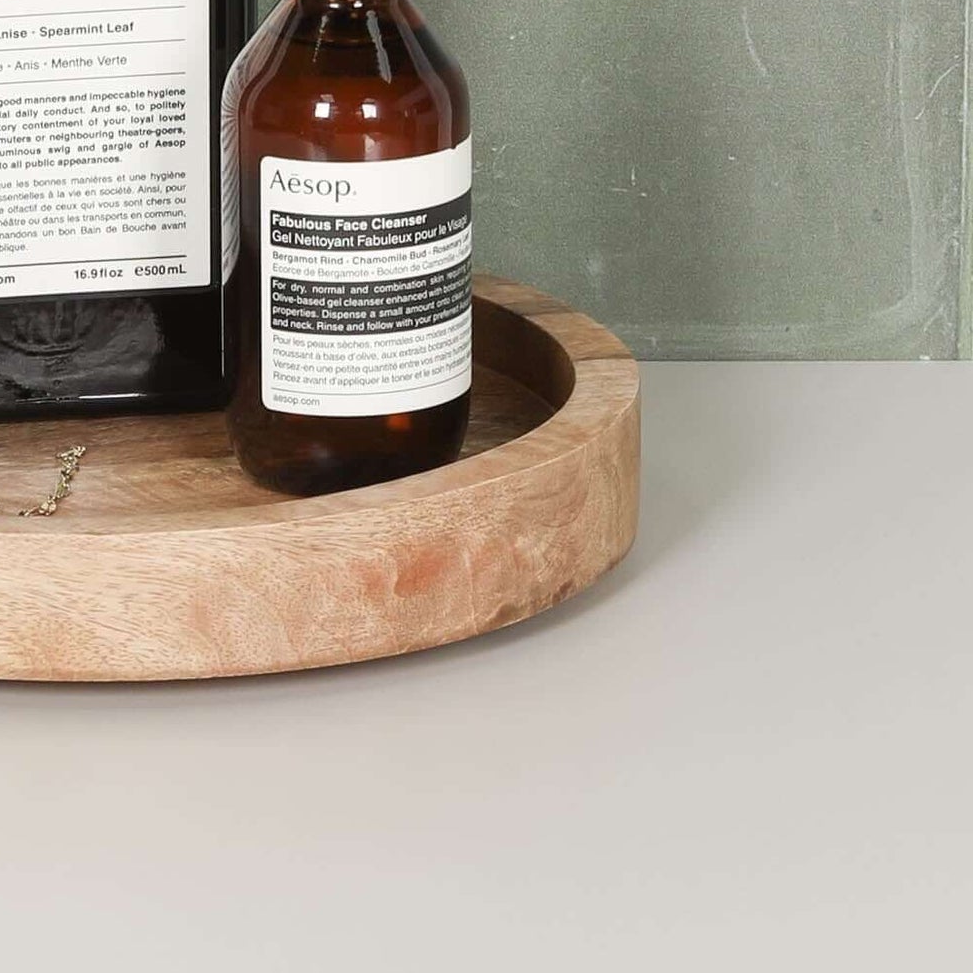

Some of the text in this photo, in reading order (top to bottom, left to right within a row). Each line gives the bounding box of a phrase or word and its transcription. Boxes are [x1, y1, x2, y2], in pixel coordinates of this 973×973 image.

[39, 23, 103, 39] Spearmint
[106, 21, 134, 33] Leaf
[13, 60, 40, 71] Anis
[50, 56, 93, 69] Menthe
[96, 55, 127, 66] Verte
[23, 95, 67, 104] manners
[68, 92, 87, 102] and
[89, 89, 145, 102] impeccable
[146, 87, 186, 99] hygiene
[14, 108, 38, 119] daily
[42, 106, 85, 116] conduct.
[90, 104, 111, 113] And
[115, 104, 130, 112] so,
[134, 102, 145, 111] to
[149, 99, 186, 112] politely
[21, 118, 83, 130] contentment
[87, 117, 98, 126] of
[102, 117, 125, 127] your
[130, 113, 154, 125] loyal
[158, 112, 186, 122] loved
[34, 134, 45, 142] or
[48, 130, 114, 142] neighbouring
[117, 126, 186, 137] theatre-goers,
[47, 144, 71, 155] swig
[76, 143, 95, 152] and
[101, 141, 133, 153] gargle
[138, 139, 149, 149] of
[154, 138, 186, 148] Aesop
[10, 159, 22, 169] all
[24, 158, 55, 170] public
[57, 155, 122, 167] appearances.
[15, 179, 29, 188] les
[32, 178, 67, 187] bonnes
[115, 173, 125, 182] et
[128, 173, 147, 182] une
[149, 170, 186, 182] hygiène
[56, 183, 187, 198] la vie en Ainsi, pour
[97, 200, 120, 208] vous
[123, 197, 143, 207] sont
[145, 196, 172, 206] chers
[173, 196, 186, 205] ou
[41, 215, 65, 224] dans
[81, 211, 128, 222] transports
[129, 211, 142, 220] en
[143, 209, 186, 219] commun,
[271, 212, 427, 231] Fabulous Face Cleanser
[41, 229, 54, 237] un
[57, 227, 76, 236] bon
[121, 222, 157, 233] Bouche
[160, 220, 187, 230] avant
[271, 229, 292, 244] Gel
[294, 232, 354, 250] Nettoyant
[357, 232, 413, 247] Fabuleux
[414, 227, 437, 244] pour
[438, 223, 447, 235] le
[271, 250, 317, 264] Bergamot
[319, 255, 343, 265] Rind
[351, 252, 407, 265] Chamomile
[409, 248, 427, 260] Bud
[74, 268, 98, 279] 16.9
[302, 267, 316, 277] de
[317, 267, 370, 280] Bergamote
[376, 265, 409, 276] Bouton
[409, 263, 421, 272] de
[272, 279, 287, 290] For
[290, 282, 307, 295] dry,
[311, 285, 345, 294] normal
[349, 284, 369, 294] and
[373, 279, 427, 293] combination
[429, 274, 444, 285] skin
[271, 291, 325, 306] Olive-based
[326, 297, 342, 308] gel
[342, 297, 385, 307] cleanser
[385, 289, 428, 305] enhanced
[428, 286, 442, 297] with
[271, 305, 319, 318] properties.
[321, 308, 367, 321] Dispense
[369, 310, 376, 318] a
[378, 306, 403, 318] small
[404, 300, 435, 315] amount
[435, 297, 450, 308] onto
[272, 317, 289, 328] and
[289, 320, 314, 330] neck.
[316, 320, 344, 332] Rinse
[345, 321, 365, 331] and
[366, 320, 394, 331] follow
[395, 317, 413, 328] with
[414, 314, 432, 327] your
[414, 334, 425, 343] ou
[302, 376, 327, 385] avant
